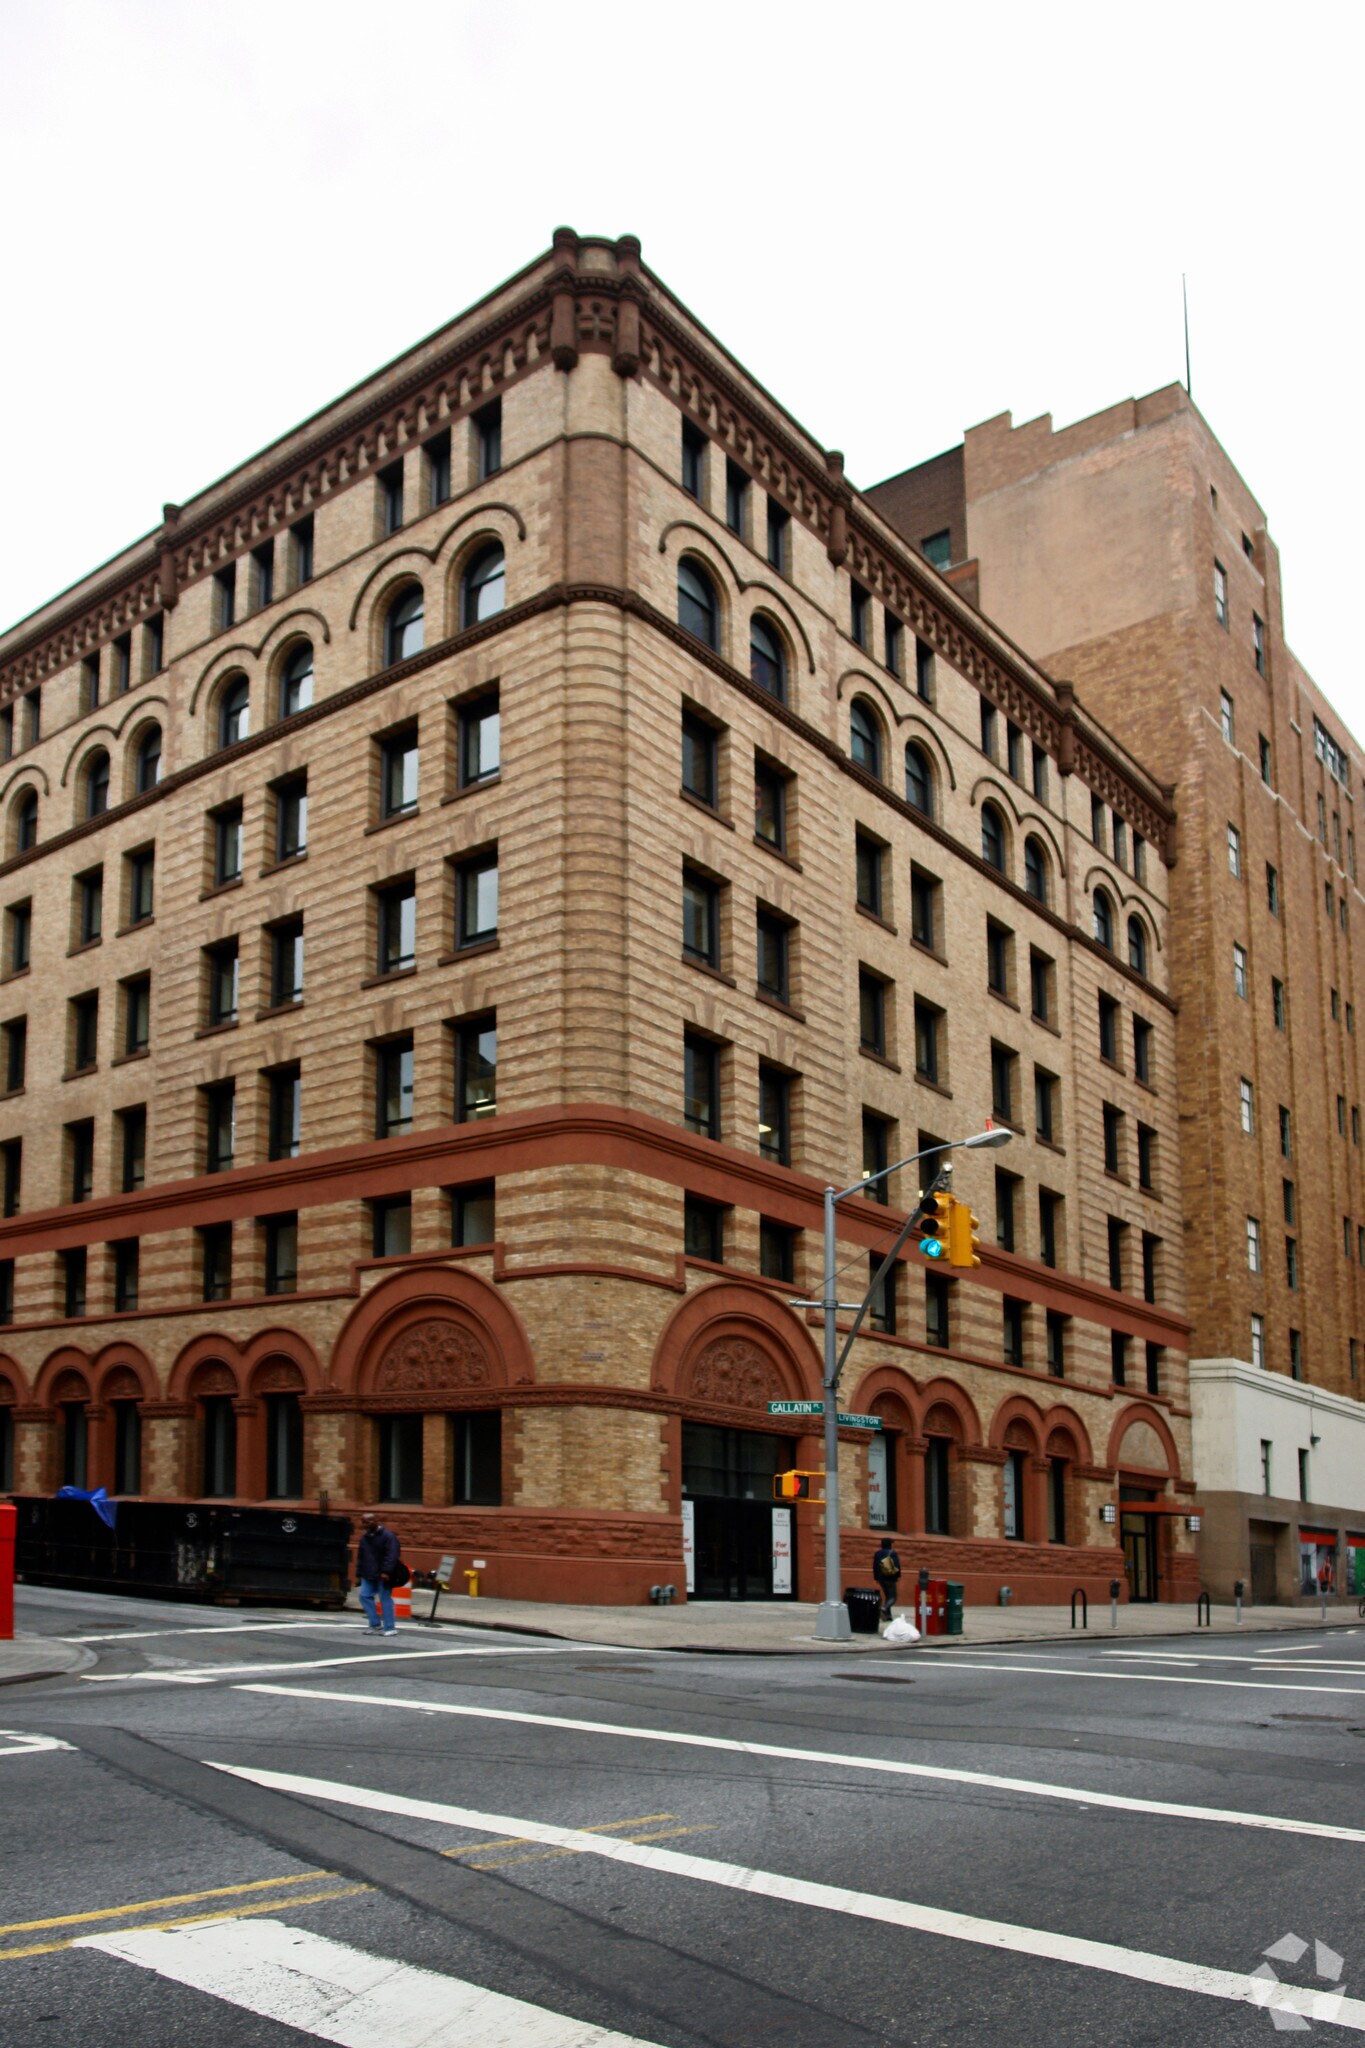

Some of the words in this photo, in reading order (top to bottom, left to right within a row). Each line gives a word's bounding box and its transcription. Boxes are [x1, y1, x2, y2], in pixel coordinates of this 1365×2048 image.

[771, 1403, 812, 1413] GALLATIN
[838, 1414, 879, 1425] LIVINGSTON
[775, 1541, 787, 1549] For
[773, 1549, 789, 1557] Rent
